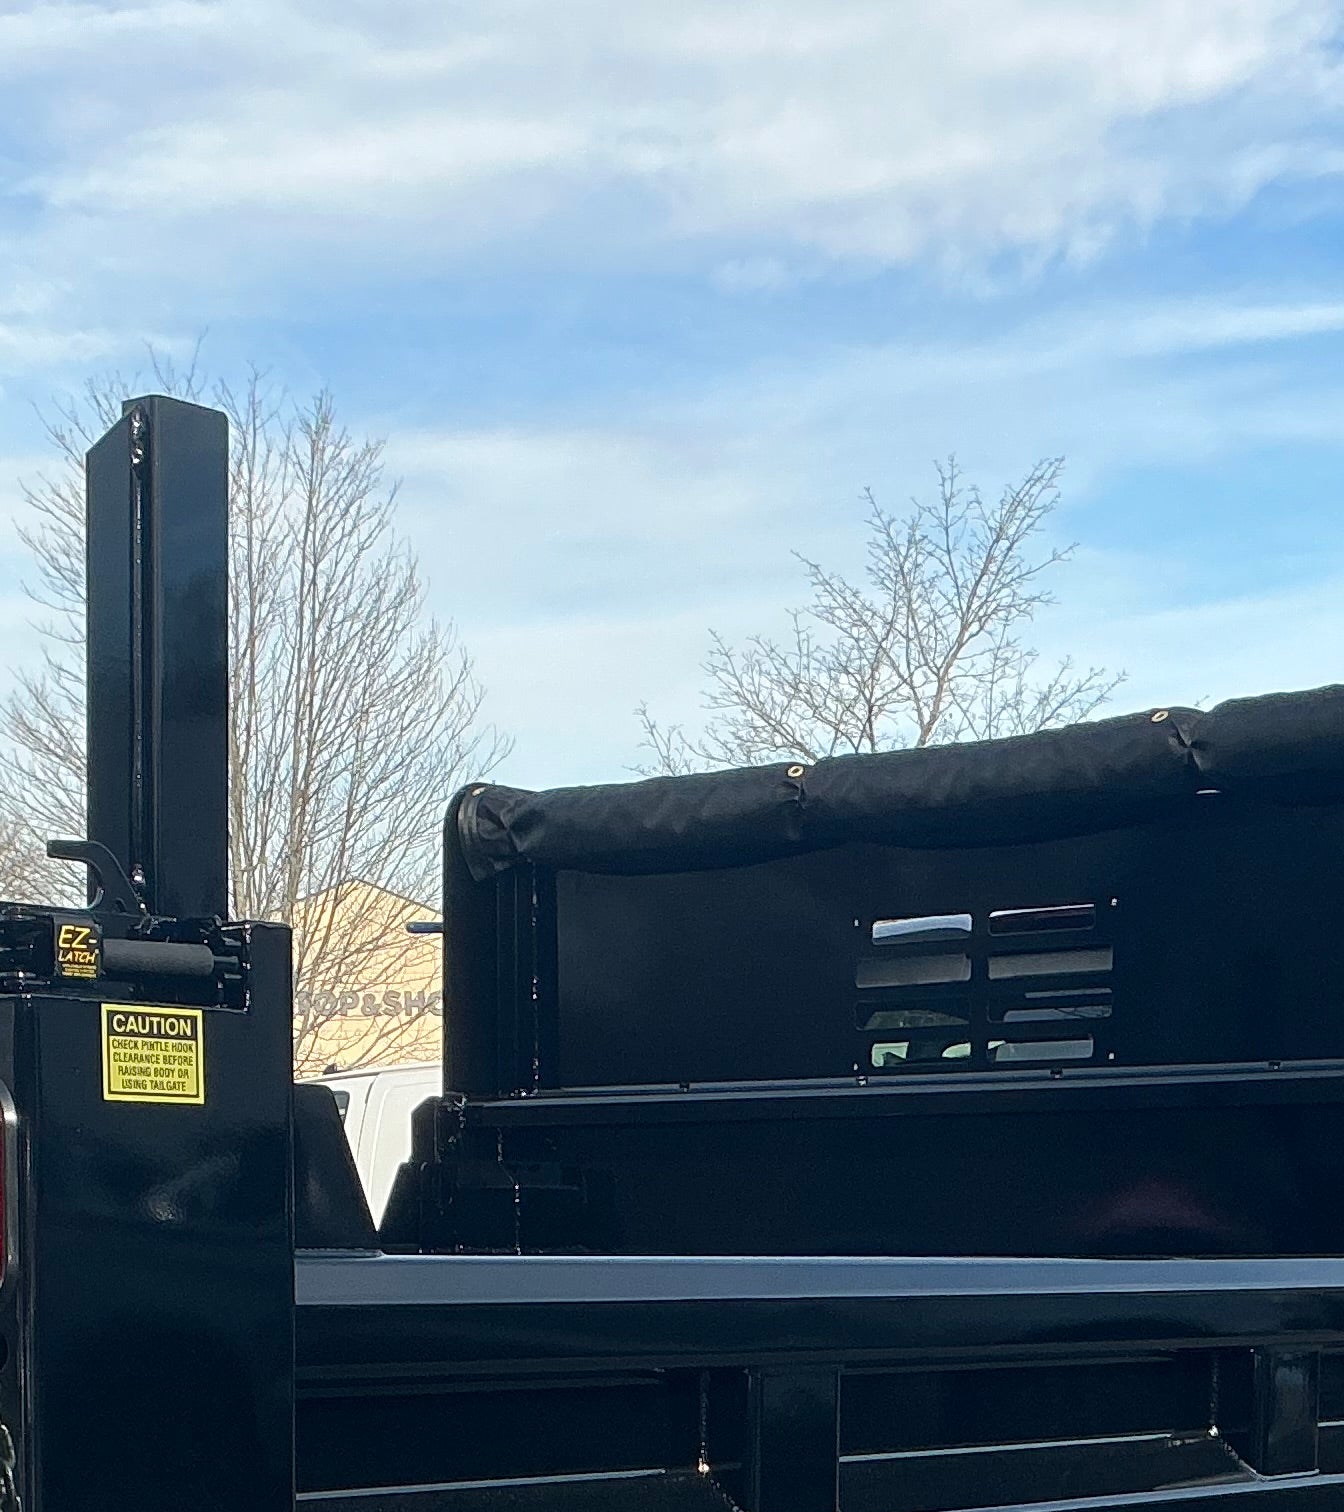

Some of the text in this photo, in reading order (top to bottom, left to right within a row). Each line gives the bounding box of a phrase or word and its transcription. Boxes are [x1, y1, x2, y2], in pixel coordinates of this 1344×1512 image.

[58, 924, 98, 949] EZ-
[57, 949, 97, 964] LATCH
[112, 1013, 193, 1037] CAUTION
[111, 1038, 140, 1051] CHECK
[171, 1042, 194, 1053] HOOK
[112, 1051, 194, 1067] CLEARANCE BEFORE
[117, 1065, 190, 1079] RAISING BODY OR
[121, 1078, 187, 1092] USING TAILGATE
